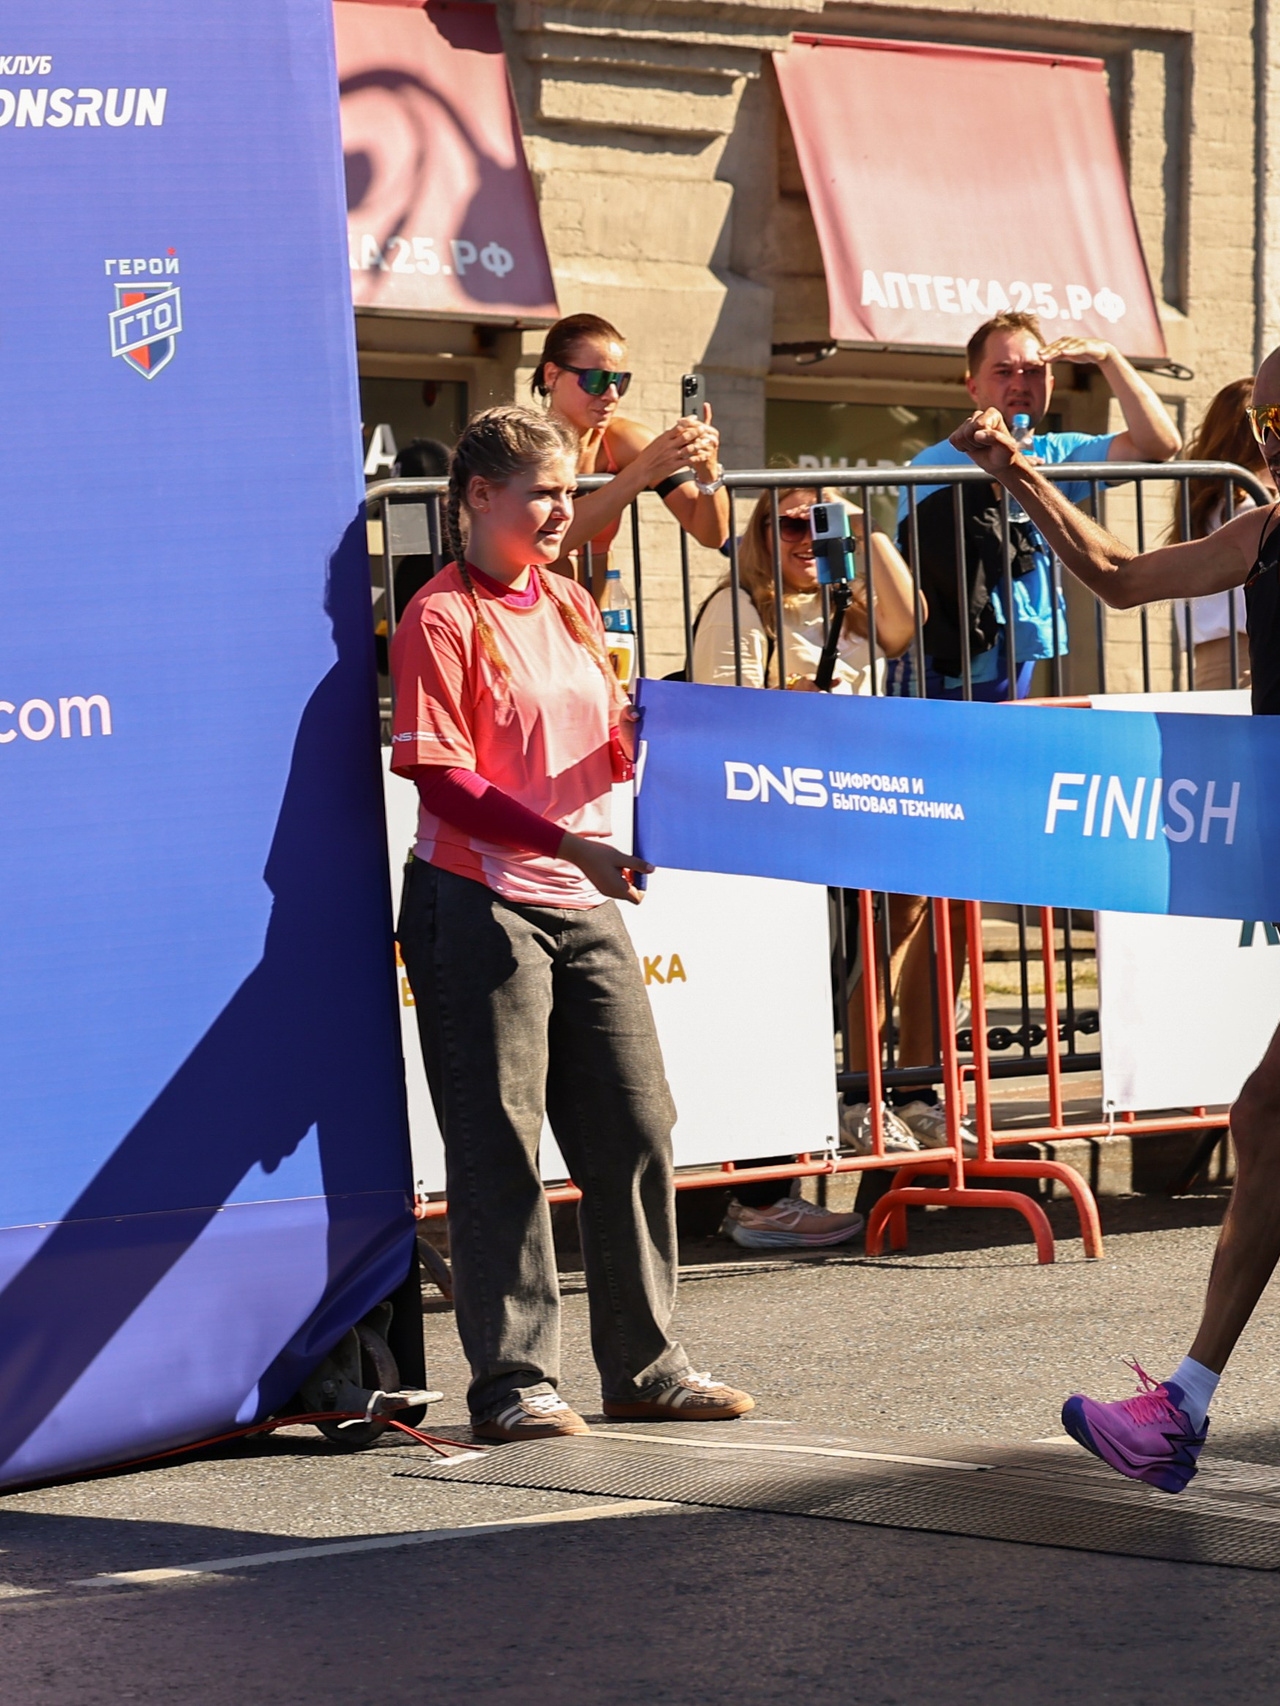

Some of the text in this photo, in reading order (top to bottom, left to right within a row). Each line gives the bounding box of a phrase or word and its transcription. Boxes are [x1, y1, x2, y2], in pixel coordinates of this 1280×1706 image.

[104, 247, 179, 275] ГЕРОЙ
[860, 269, 1126, 323] АПТЕКА25.РФ
[119, 302, 173, 344] ГТО
[724, 761, 828, 808] DNS
[829, 770, 924, 794] ЦИФРОВАЯ И
[832, 793, 965, 820] БЫТОВАЯ ТЕХНИКА
[1044, 772, 1240, 845] FINISH
